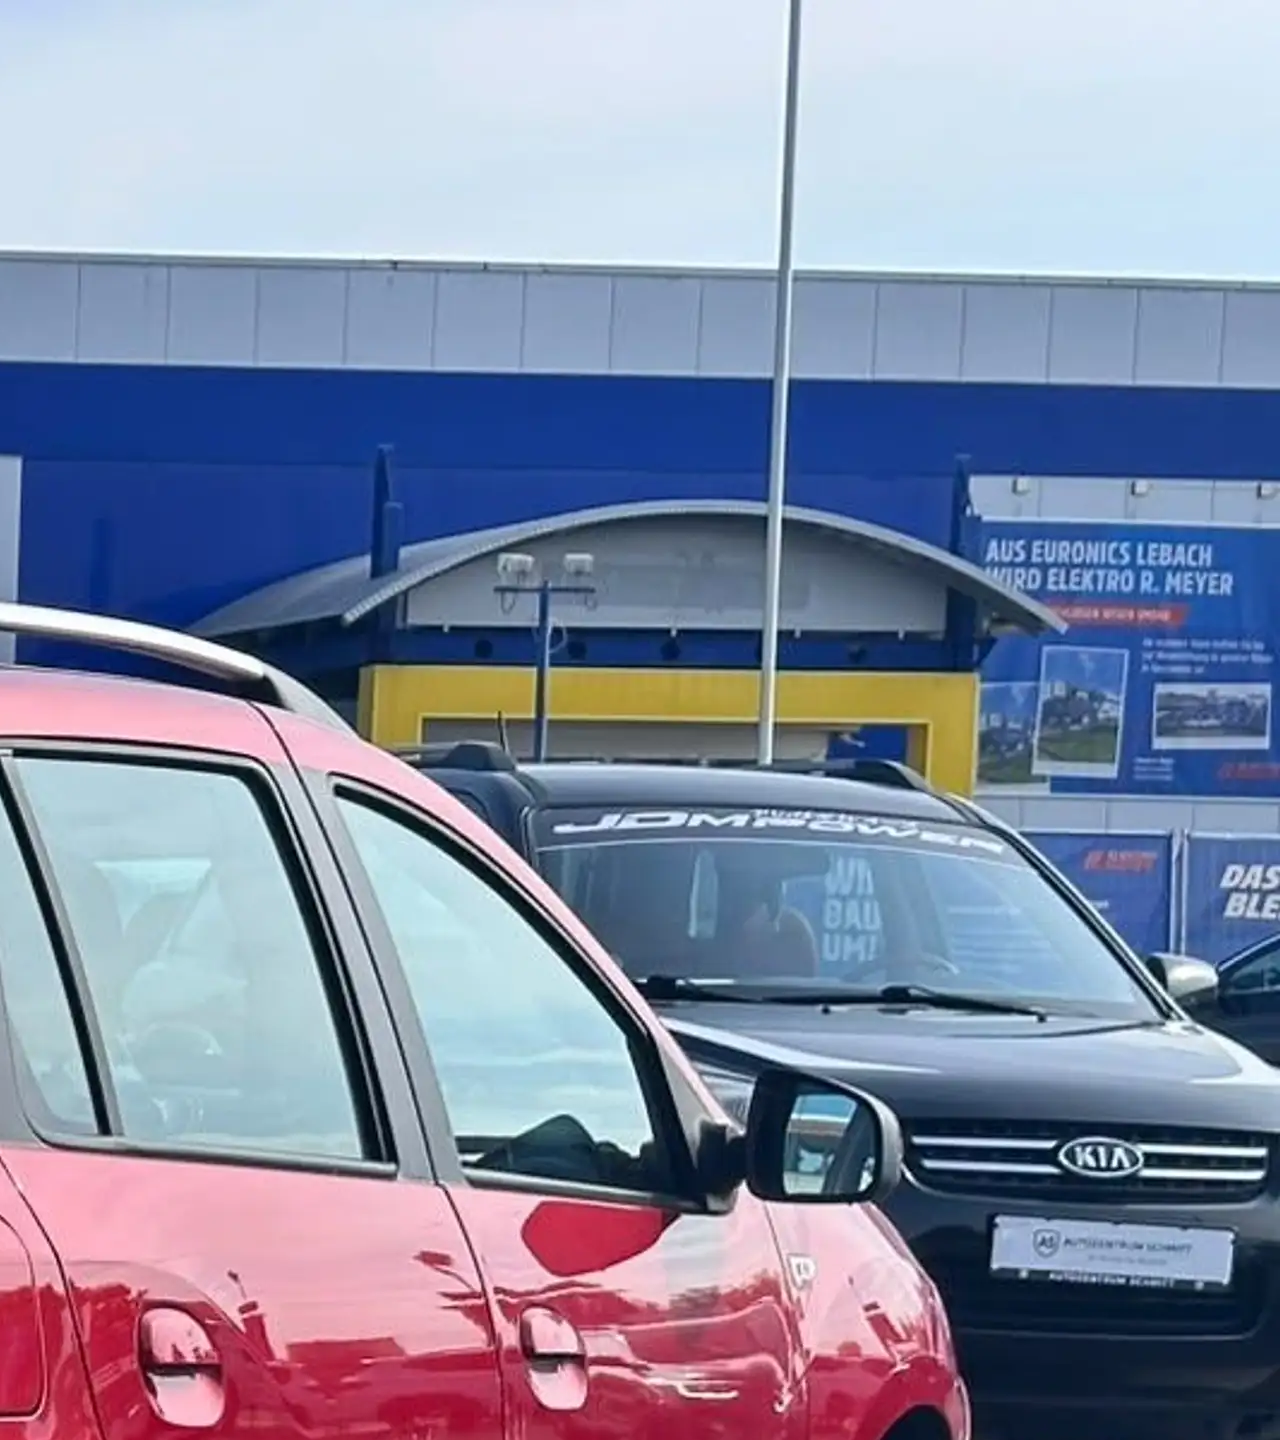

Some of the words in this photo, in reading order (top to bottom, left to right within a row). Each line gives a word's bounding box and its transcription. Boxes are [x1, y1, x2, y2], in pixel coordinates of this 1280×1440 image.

[986, 539, 1026, 563] AUS
[1031, 541, 1130, 565] EURONICS
[1136, 544, 1212, 566] LEBACH
[1047, 569, 1133, 592] ELEKTRO
[1140, 572, 1160, 593] R.
[1165, 572, 1233, 596] MEYER
[1220, 864, 1280, 890] DAS
[1224, 893, 1280, 919] BLE
[1074, 1145, 1131, 1169] KIA
